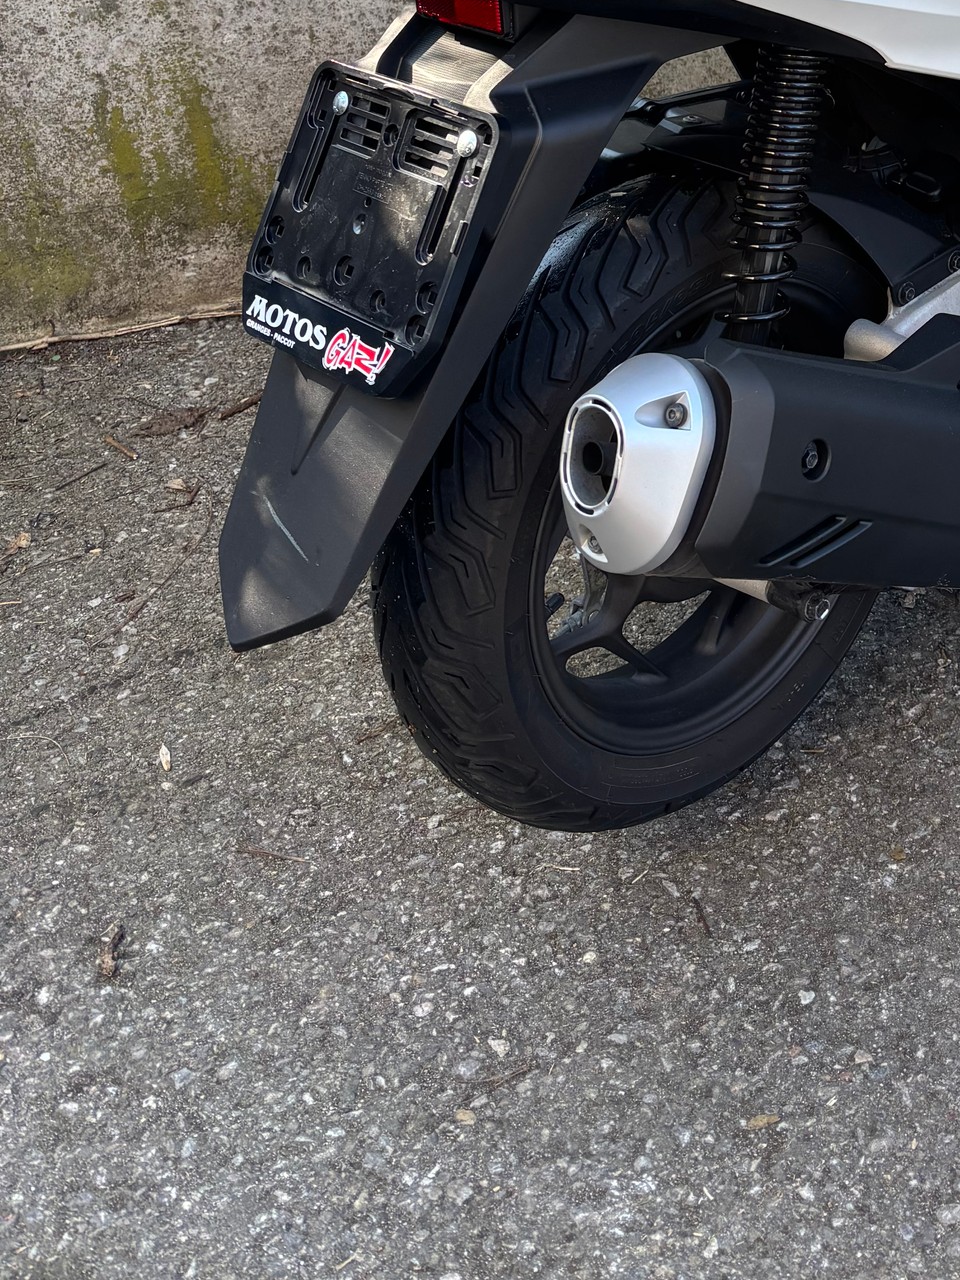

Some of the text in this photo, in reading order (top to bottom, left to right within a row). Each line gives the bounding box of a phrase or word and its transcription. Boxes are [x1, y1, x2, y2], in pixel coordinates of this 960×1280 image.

[245, 294, 395, 377] MOTOS GAZ!
[246, 318, 271, 337] GRANGES
[273, 332, 296, 349] PACCOT
